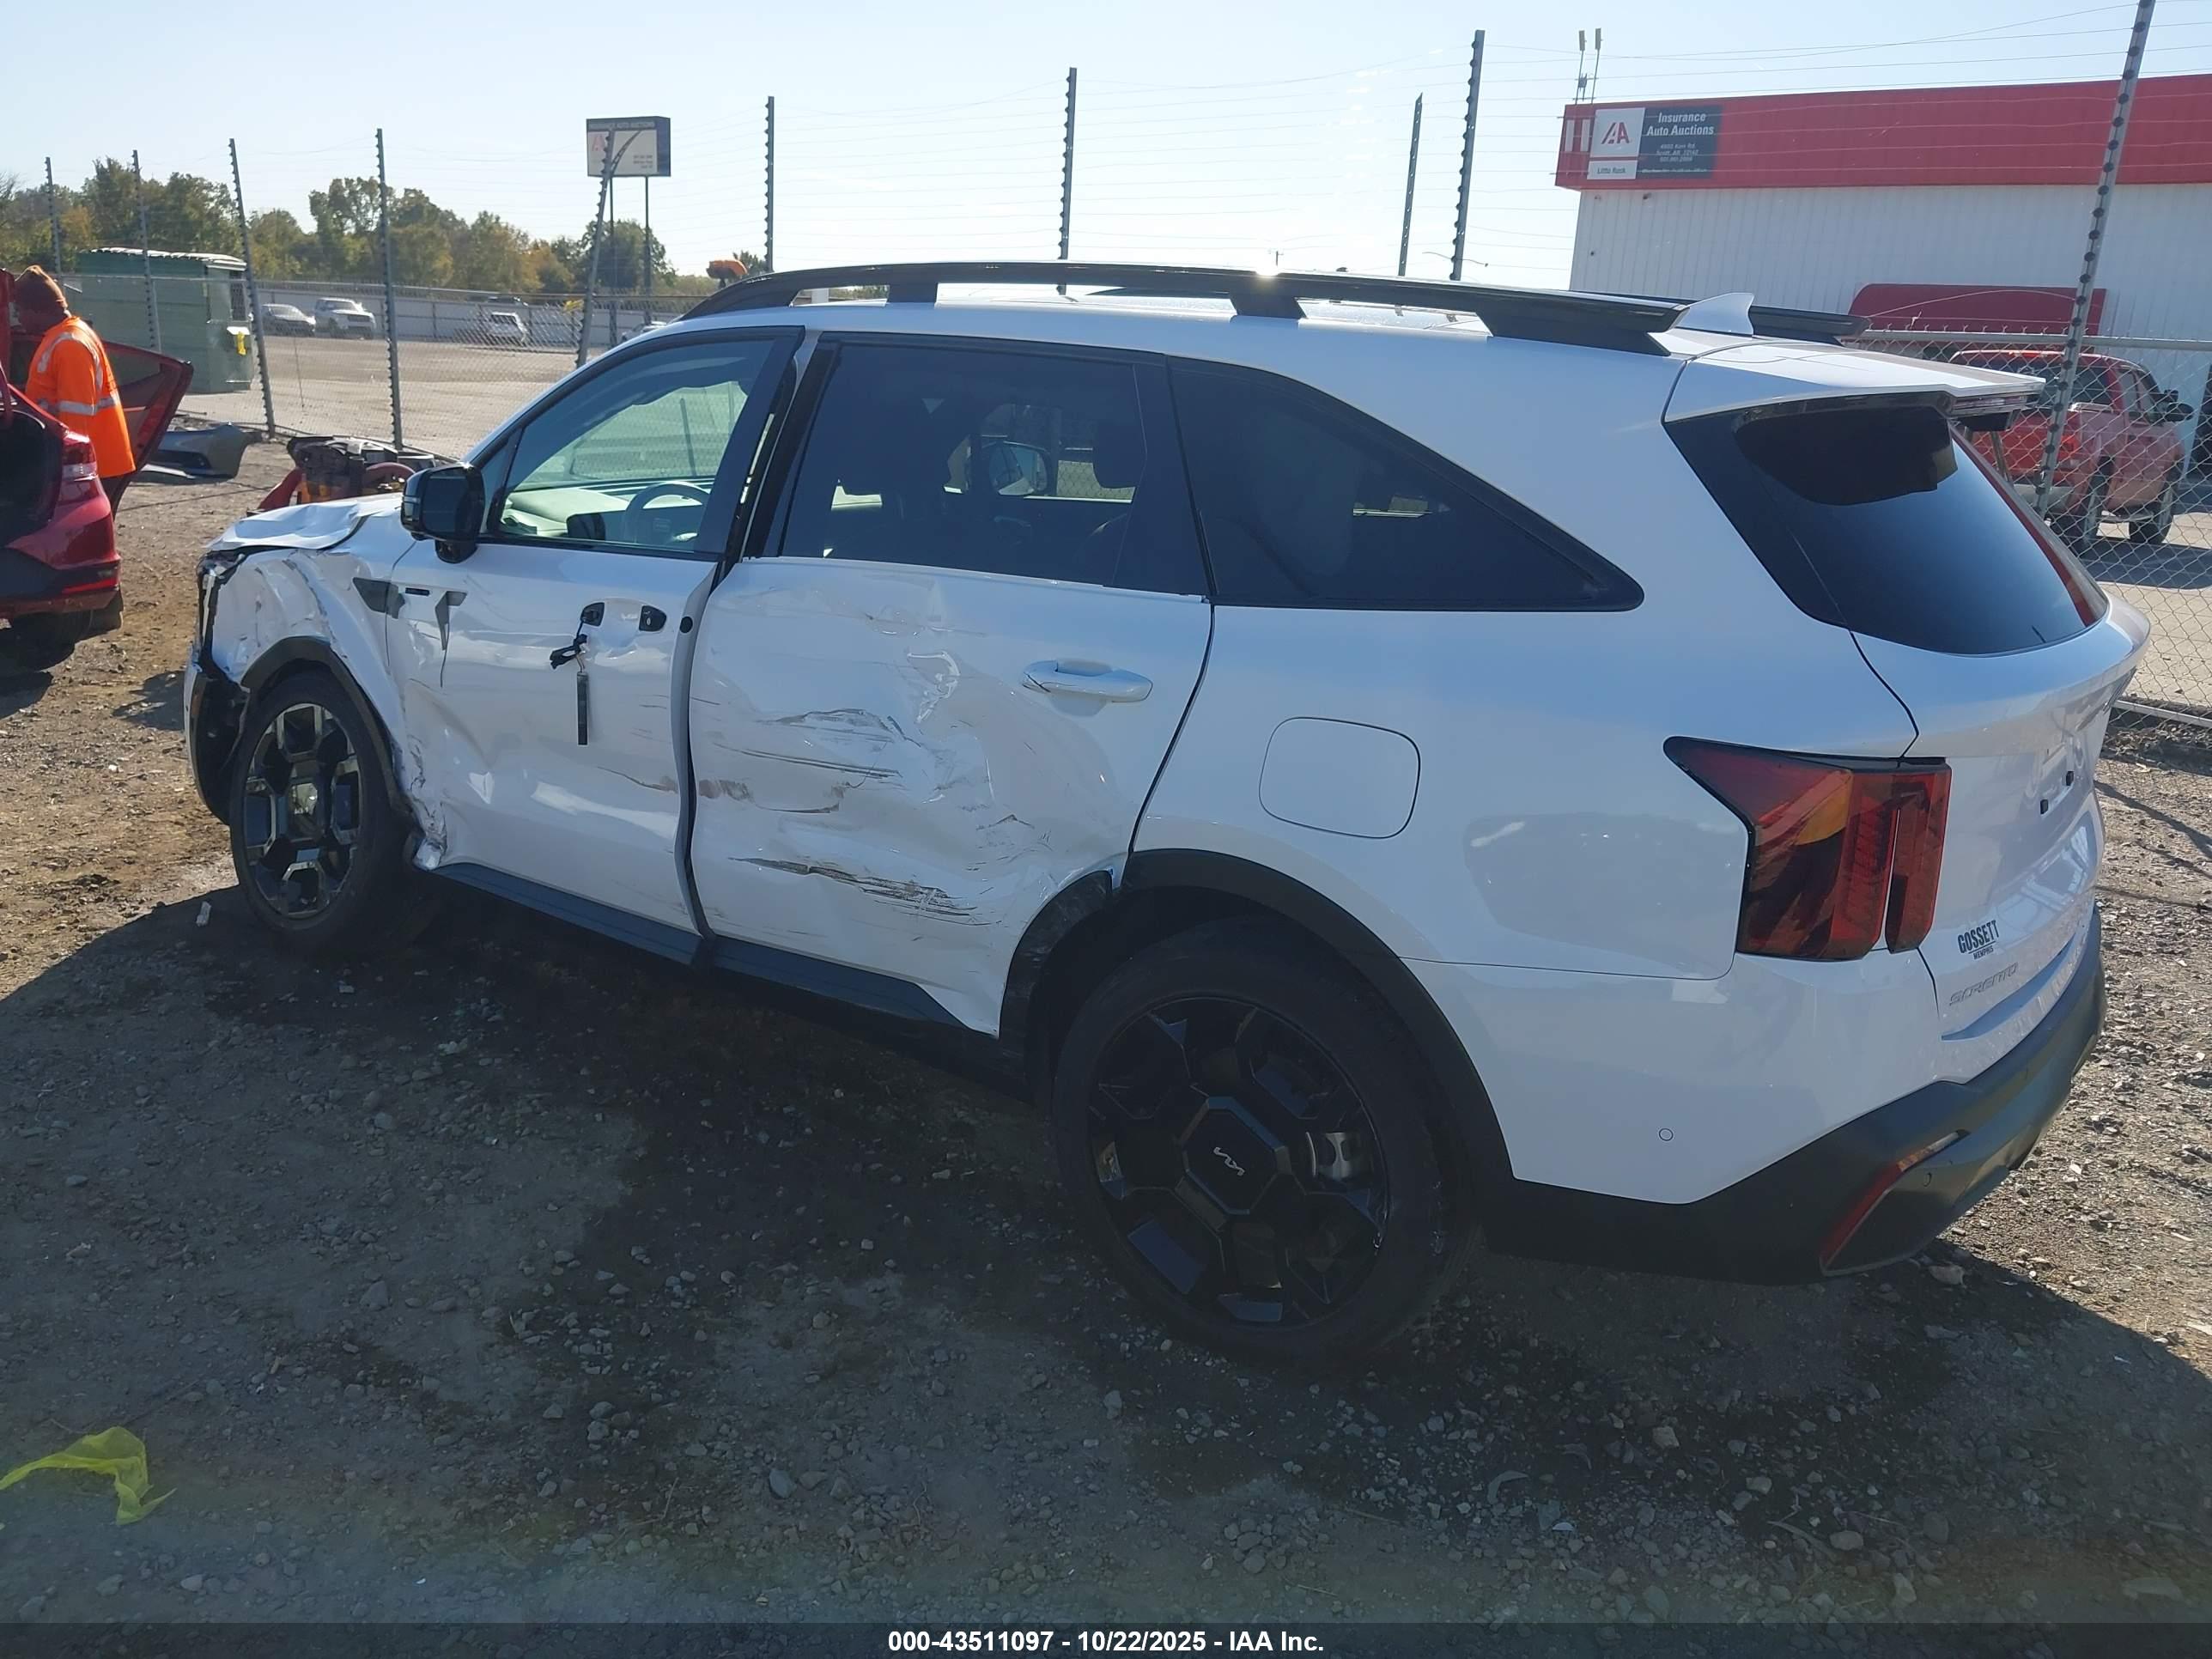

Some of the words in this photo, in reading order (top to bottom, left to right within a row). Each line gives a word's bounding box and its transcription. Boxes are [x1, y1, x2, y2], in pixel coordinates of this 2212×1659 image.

[1658, 112, 1707, 124] Insurance
[1647, 125, 1669, 137] Auto
[1670, 124, 1715, 136] Auctions
[1957, 920, 1999, 953] GOSSETT
[1973, 945, 1994, 960] MEMPHIS
[1948, 962, 2018, 1006] SORENTO
